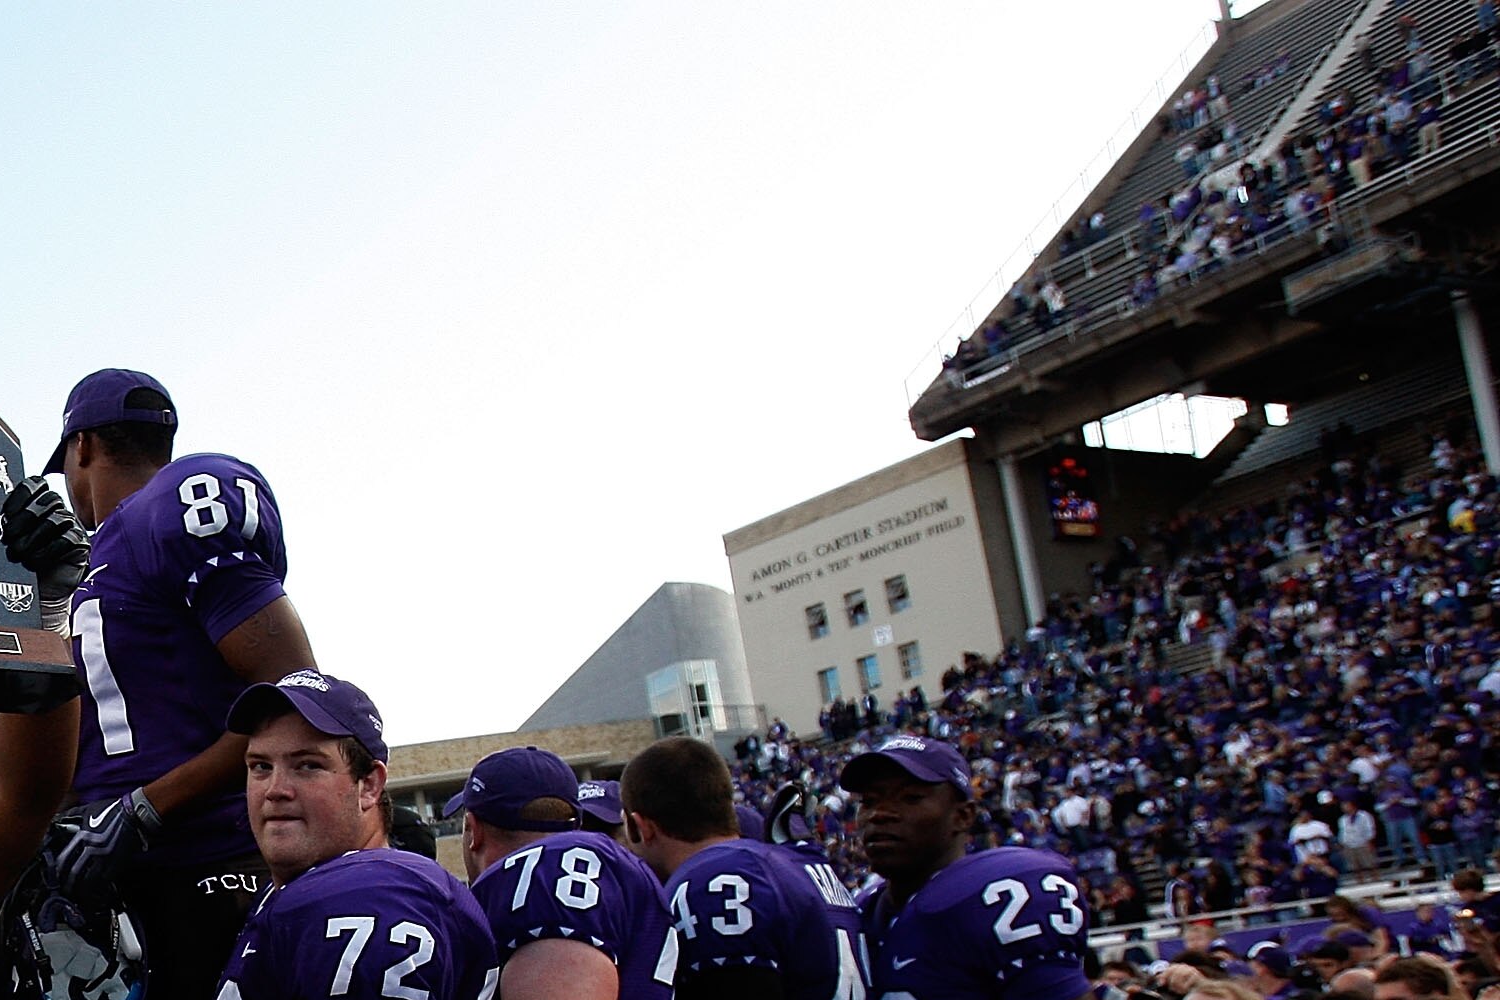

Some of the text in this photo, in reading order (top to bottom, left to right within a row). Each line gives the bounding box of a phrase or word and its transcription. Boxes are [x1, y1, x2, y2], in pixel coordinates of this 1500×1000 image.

[179, 472, 259, 540] 81
[751, 558, 792, 582] AMON
[815, 525, 874, 558] CARTER
[877, 497, 949, 535] STADIUM
[197, 873, 258, 895] TCU
[504, 845, 601, 911] 78
[669, 874, 753, 939] 43
[983, 873, 1084, 944] 23
